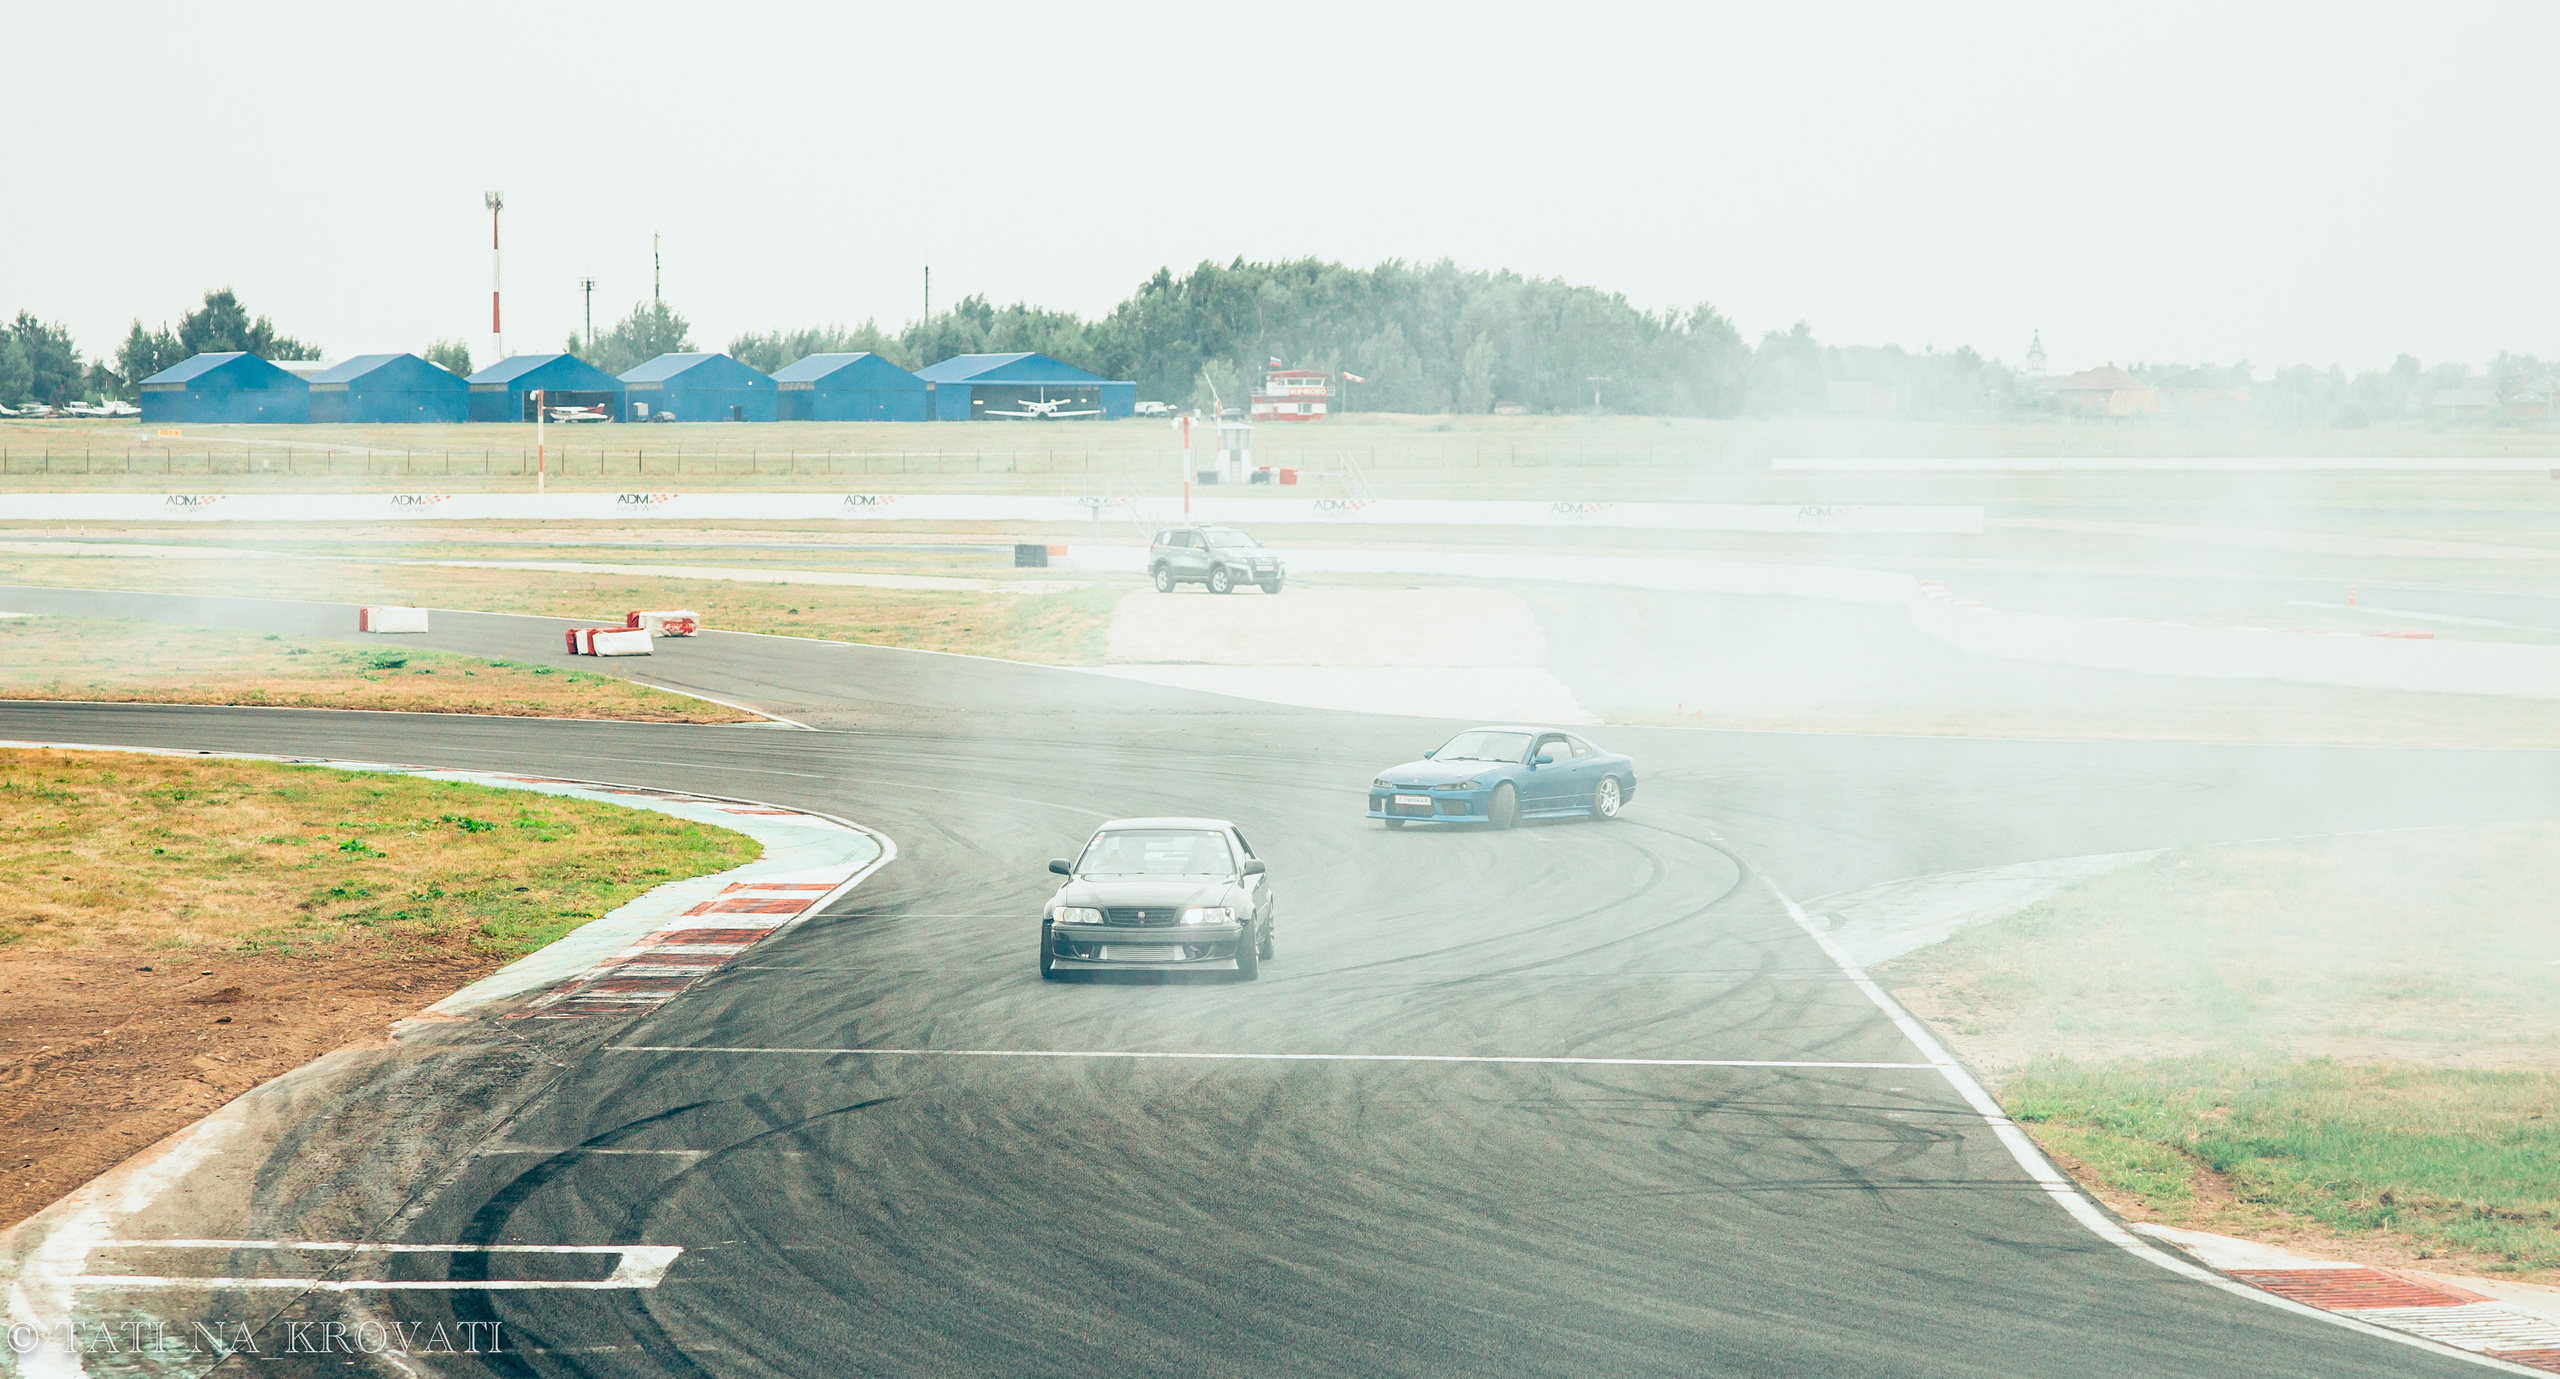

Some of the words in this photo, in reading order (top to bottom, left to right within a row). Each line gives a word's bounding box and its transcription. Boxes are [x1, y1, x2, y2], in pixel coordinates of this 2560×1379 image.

[1290, 387, 1326, 396] МЯЧКОВО
[166, 495, 197, 506] ADM
[391, 495, 422, 505] ADM
[617, 494, 649, 504] ADM
[844, 495, 876, 506] ADM
[165, 505, 208, 513] RACEWAY
[389, 505, 433, 513] RACEWAY
[617, 504, 660, 512] RACEWAY
[1314, 500, 1346, 510] ADM
[1550, 502, 1583, 513] ADM
[1798, 506, 1831, 517] ADM
